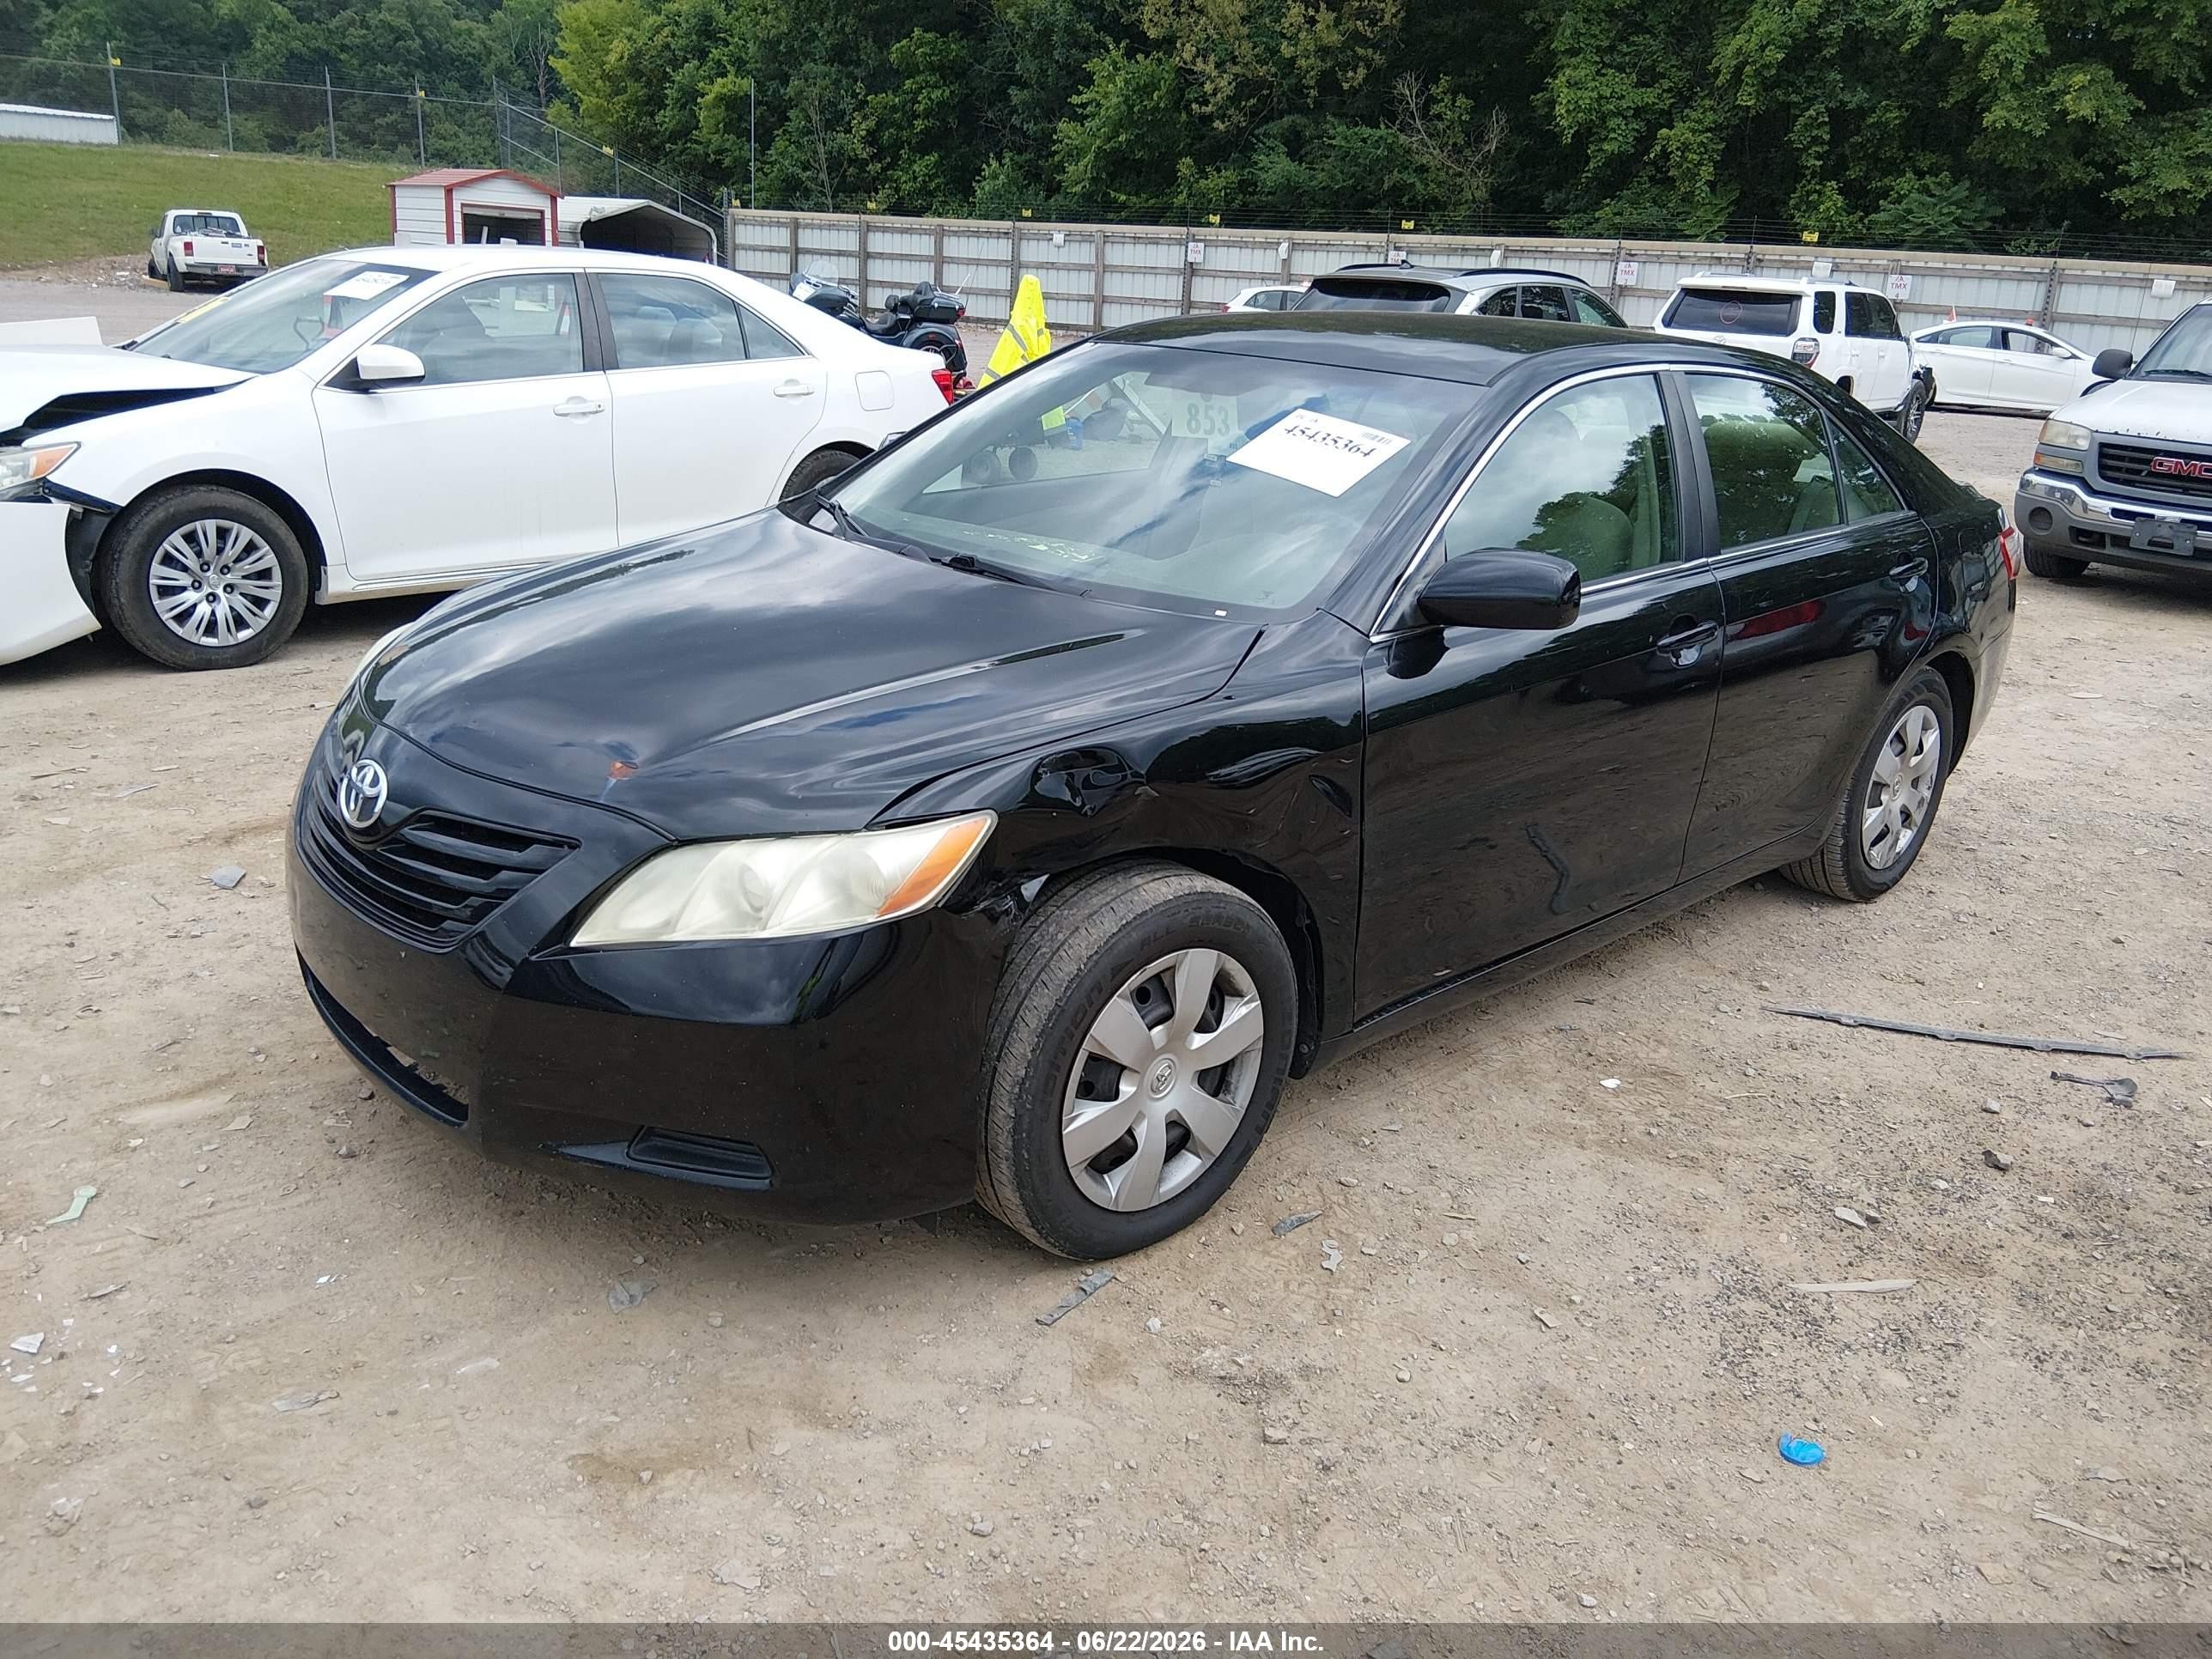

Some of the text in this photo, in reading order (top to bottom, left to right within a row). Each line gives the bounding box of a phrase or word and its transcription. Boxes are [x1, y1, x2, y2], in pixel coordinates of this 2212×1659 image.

[1187, 403, 1231, 436] 853
[1284, 424, 1377, 458] 45435364
[2151, 457, 2212, 479] GMC
